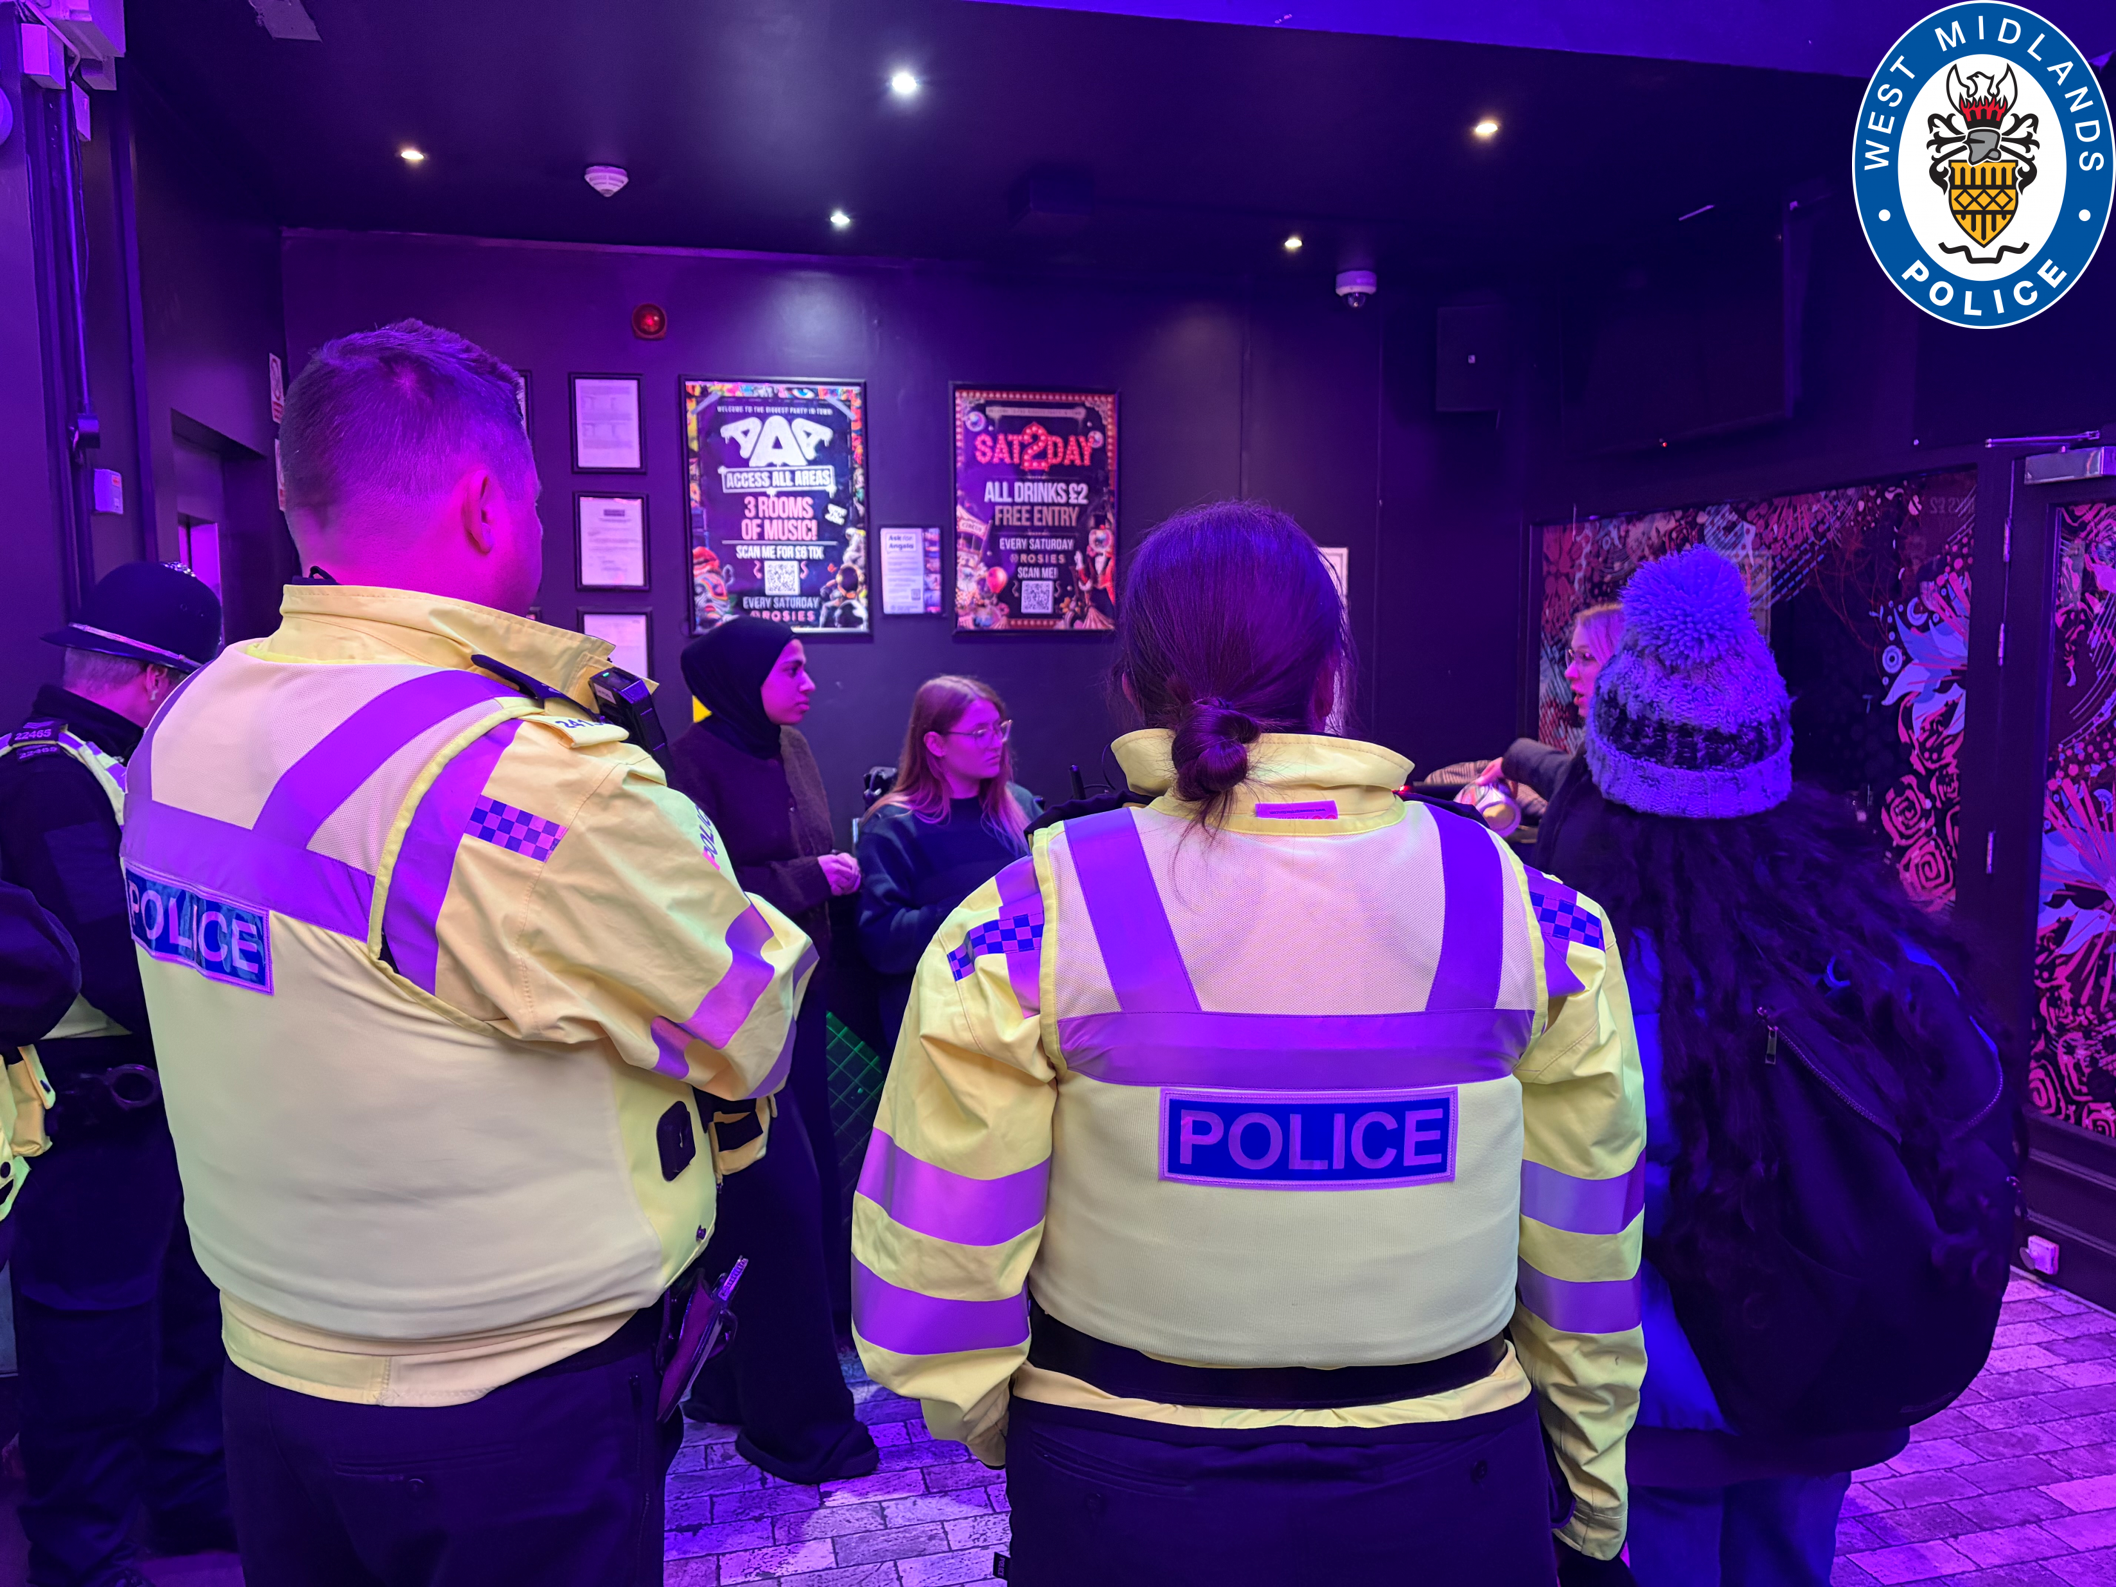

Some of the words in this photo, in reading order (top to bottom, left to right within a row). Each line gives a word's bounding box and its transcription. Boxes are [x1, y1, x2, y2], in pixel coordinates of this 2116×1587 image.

[974, 422, 1095, 471] SAT2DAY
[726, 471, 770, 488] ACCESS
[772, 471, 794, 486] ALL
[795, 469, 830, 486] AREAS
[984, 481, 1012, 503] ALL
[1014, 482, 1067, 504] DRINKS
[1068, 483, 1089, 505] £2
[744, 496, 756, 518] 3
[758, 496, 814, 519] ROOMS
[995, 505, 1031, 526] FREE
[1033, 506, 1079, 527] ENTRY
[741, 519, 762, 540] OF
[764, 519, 818, 541] MUSIC!
[736, 545, 760, 559] SCAN
[762, 545, 776, 559] ME
[777, 546, 794, 559] FOR
[795, 546, 808, 560] £6
[808, 546, 825, 560] TIX
[889, 543, 914, 551] Angela
[999, 538, 1027, 550] EVERY
[1029, 538, 1074, 550] SATURDAY
[1017, 567, 1041, 579] SCAN
[1042, 567, 1058, 579] ME!
[743, 596, 771, 609] EVERY
[773, 597, 819, 609] SATURDAY
[14, 728, 52, 741] 22465
[128, 879, 259, 974] POLICE
[1179, 1108, 1444, 1170] POLICE
